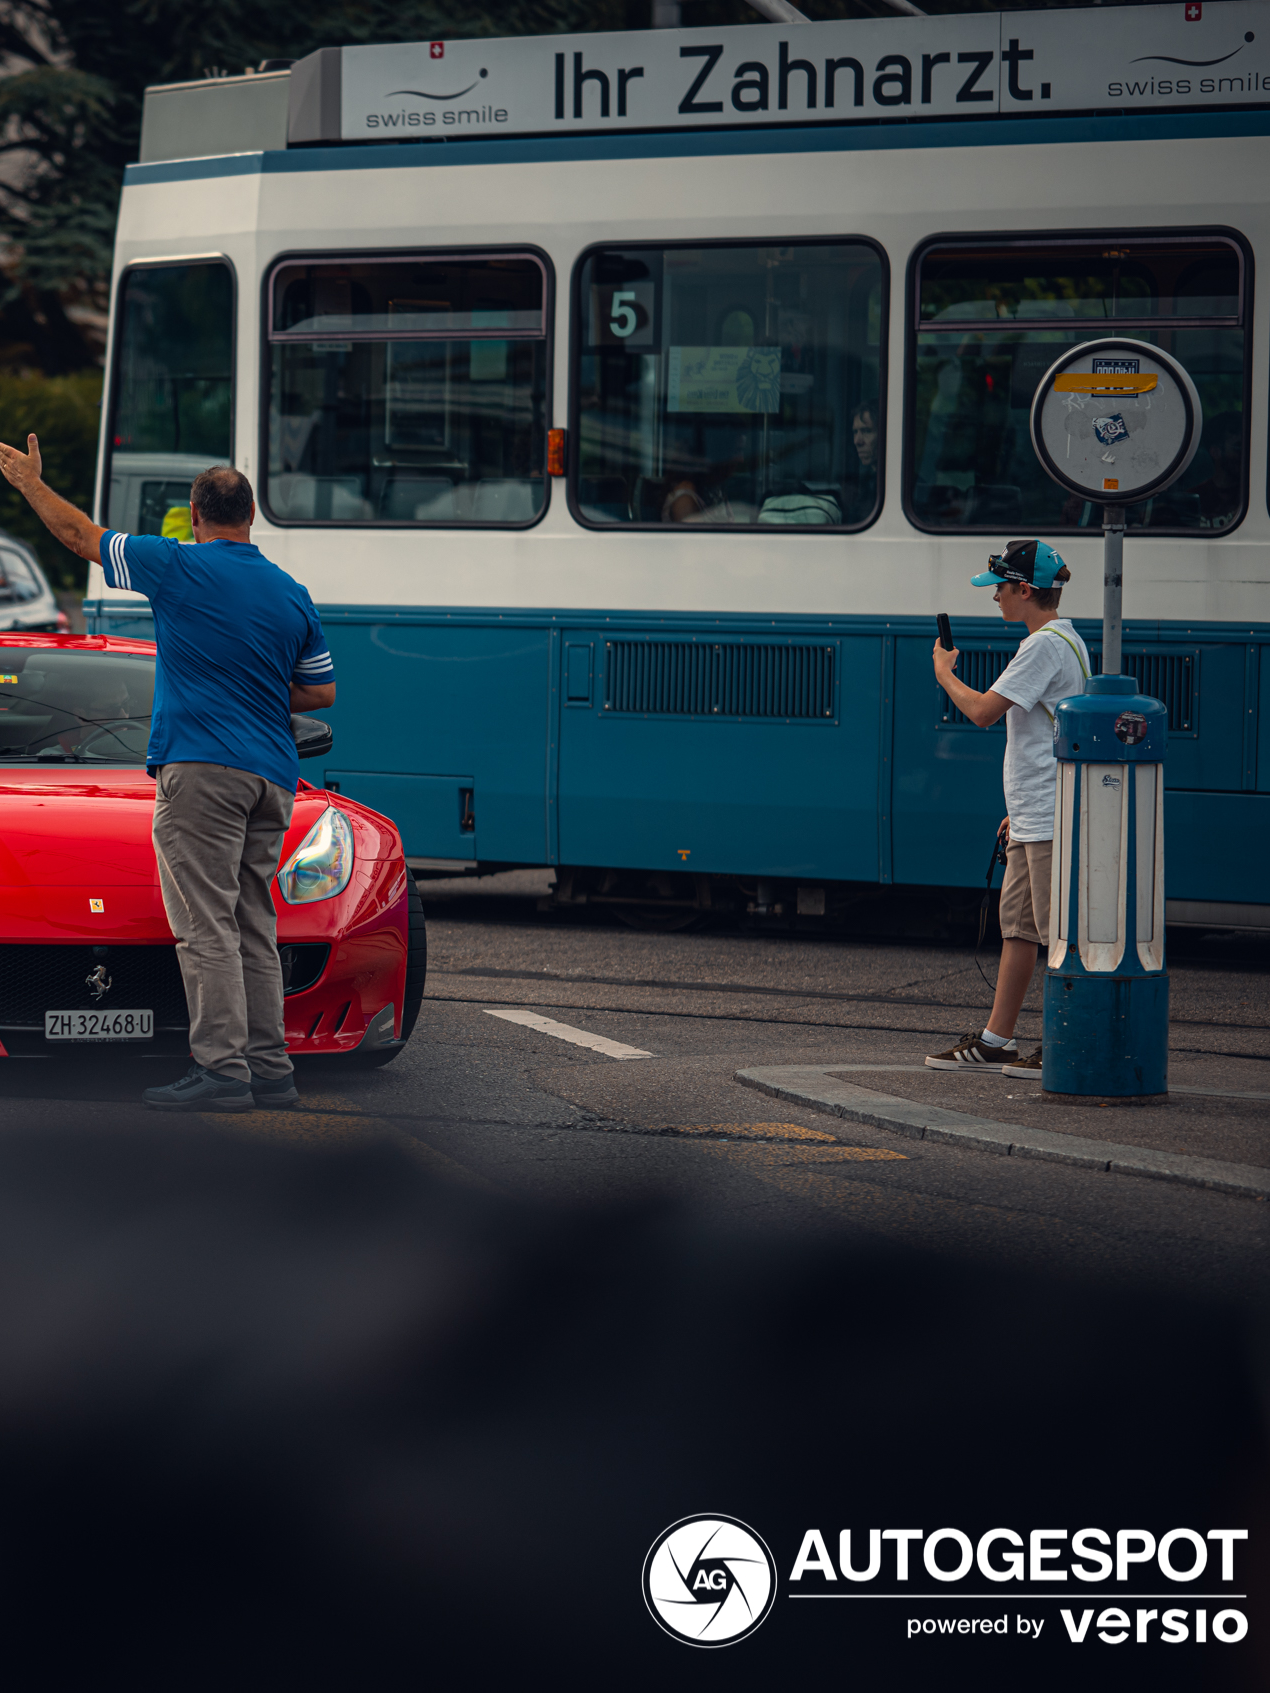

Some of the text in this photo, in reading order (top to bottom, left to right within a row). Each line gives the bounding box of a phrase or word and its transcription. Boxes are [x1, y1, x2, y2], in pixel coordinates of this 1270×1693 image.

[555, 38, 1052, 120] Ihr Zahnarzt.
[1107, 75, 1192, 97] swiss
[366, 105, 509, 128] swiss smile
[610, 291, 637, 337] 5
